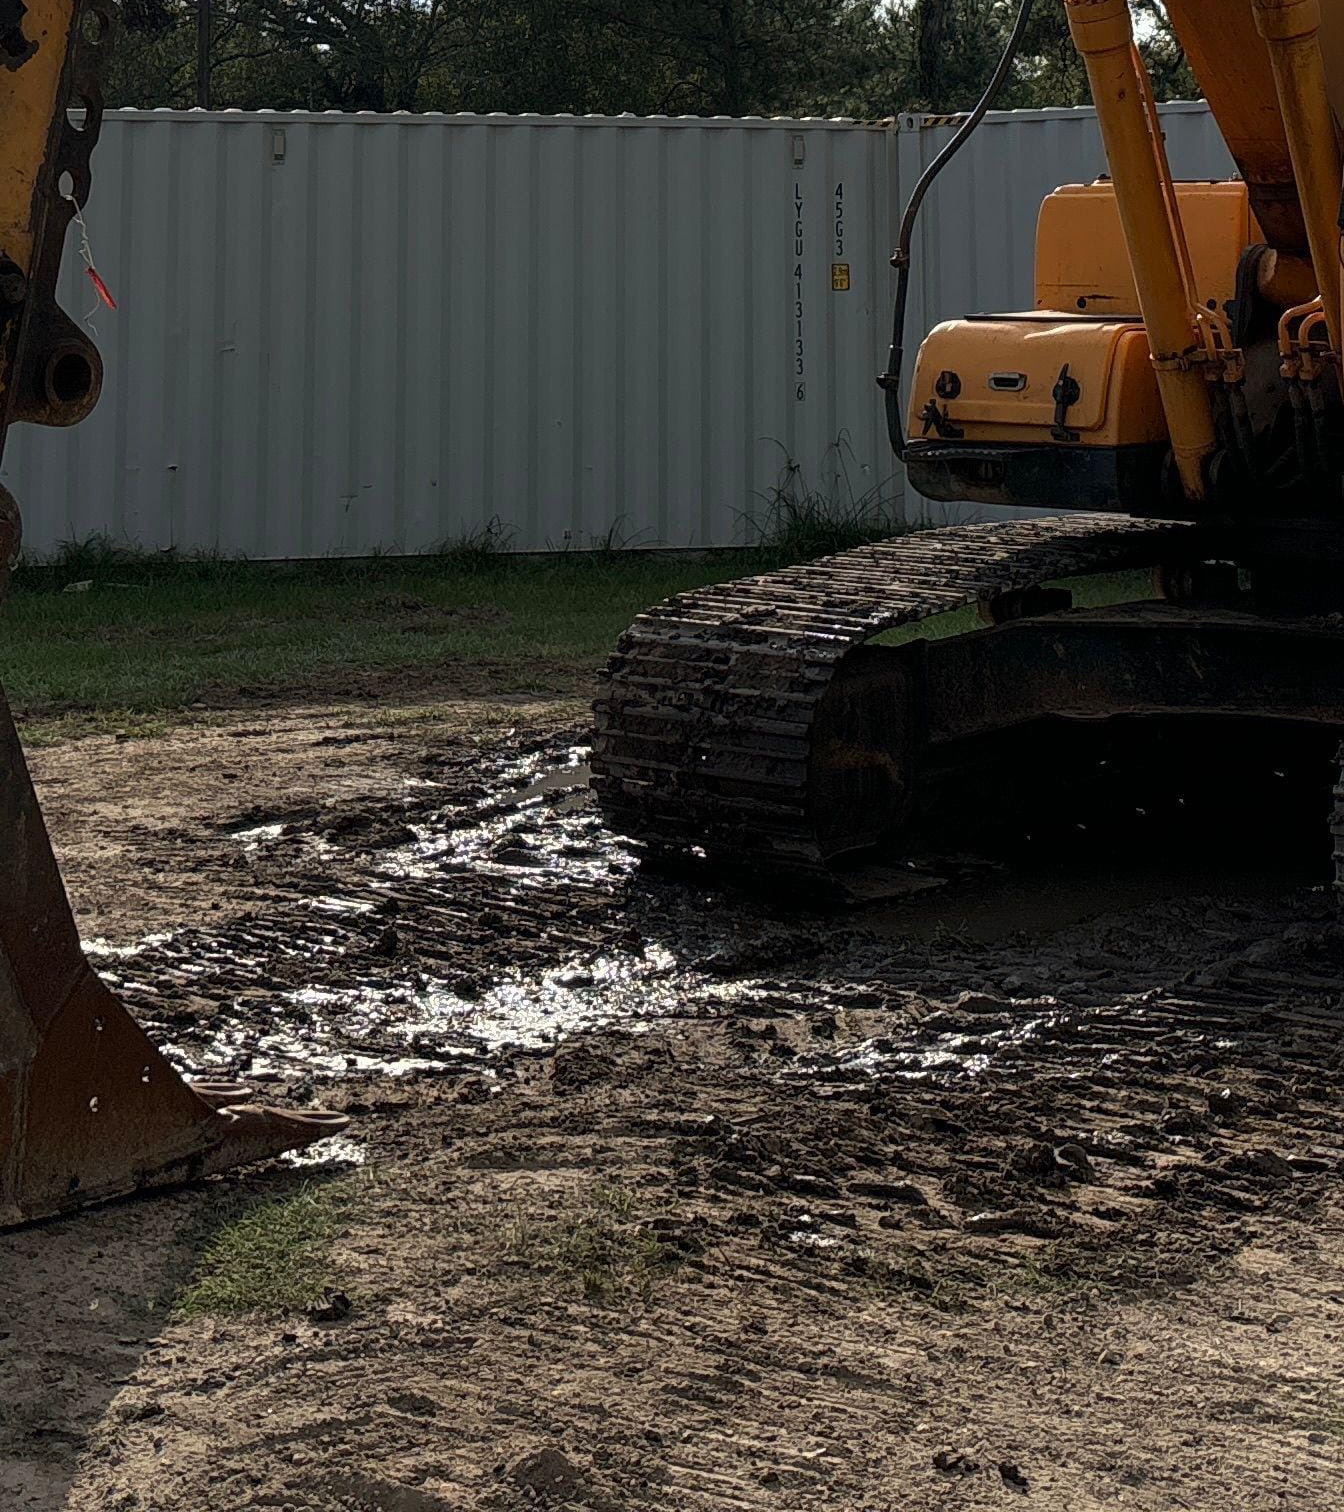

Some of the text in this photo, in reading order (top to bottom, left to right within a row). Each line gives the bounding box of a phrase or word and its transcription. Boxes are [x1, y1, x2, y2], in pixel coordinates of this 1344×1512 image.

[794, 182, 803, 257] LYGU
[835, 182, 843, 257] 45G3
[794, 263, 804, 376] 413133
